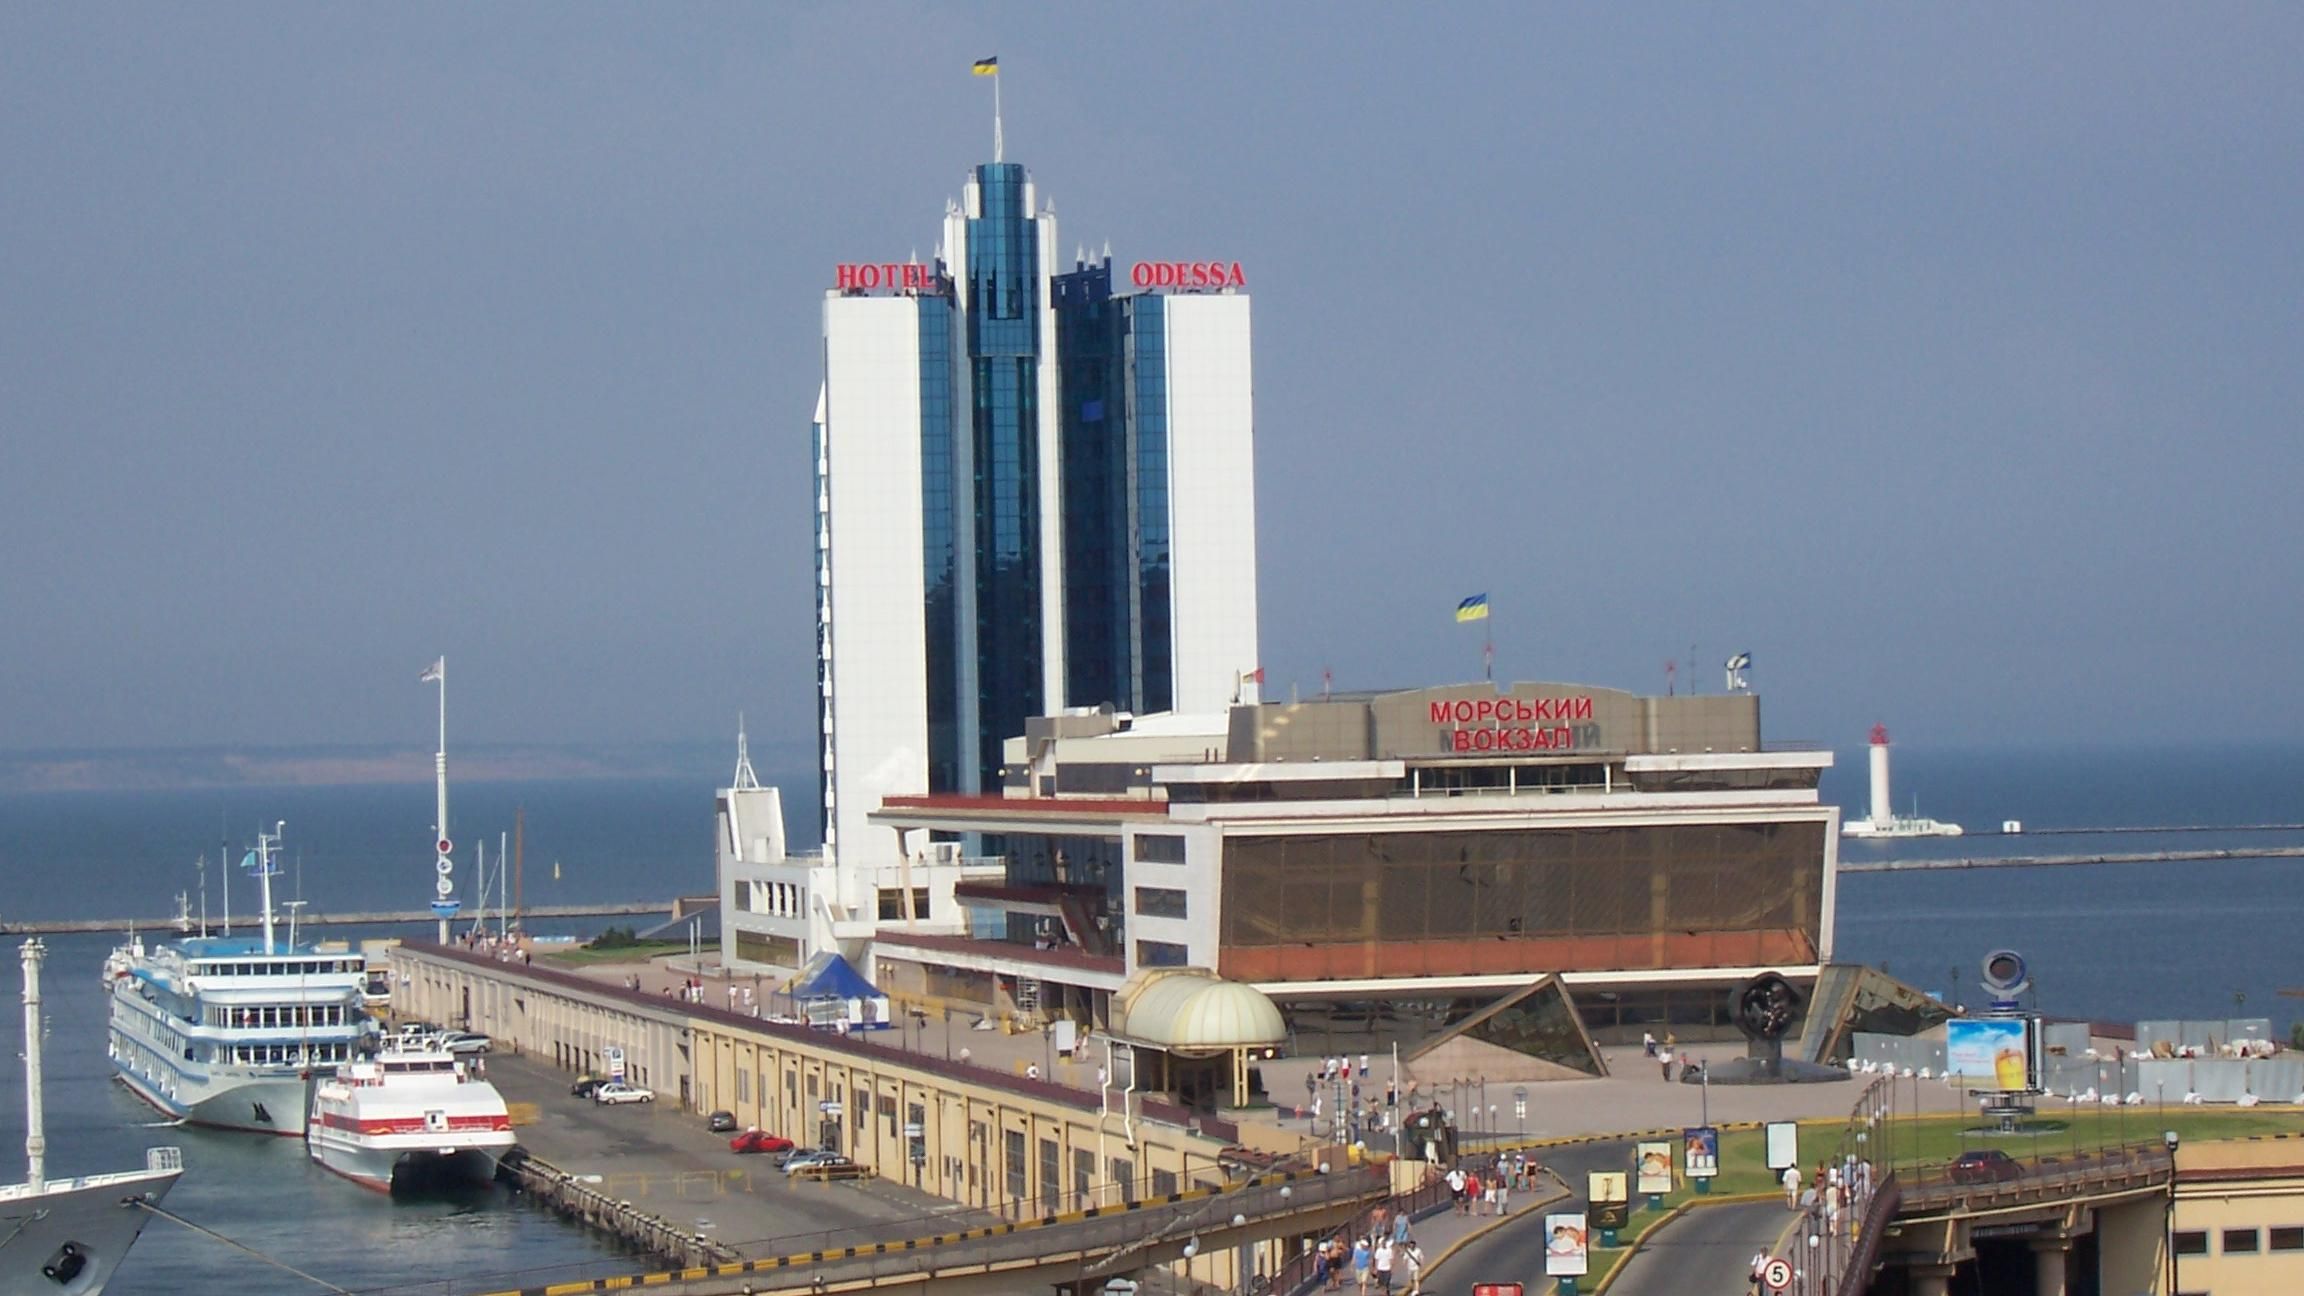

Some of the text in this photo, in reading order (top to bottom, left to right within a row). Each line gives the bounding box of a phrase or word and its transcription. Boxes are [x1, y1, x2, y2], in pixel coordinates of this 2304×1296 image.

[836, 261, 1246, 289] HOTEL ODESSA
[1430, 694, 1593, 722] МОРСЬКИЙ
[1453, 728, 1573, 752] ВОКЗАЛ
[1773, 1265, 1783, 1283] 5
